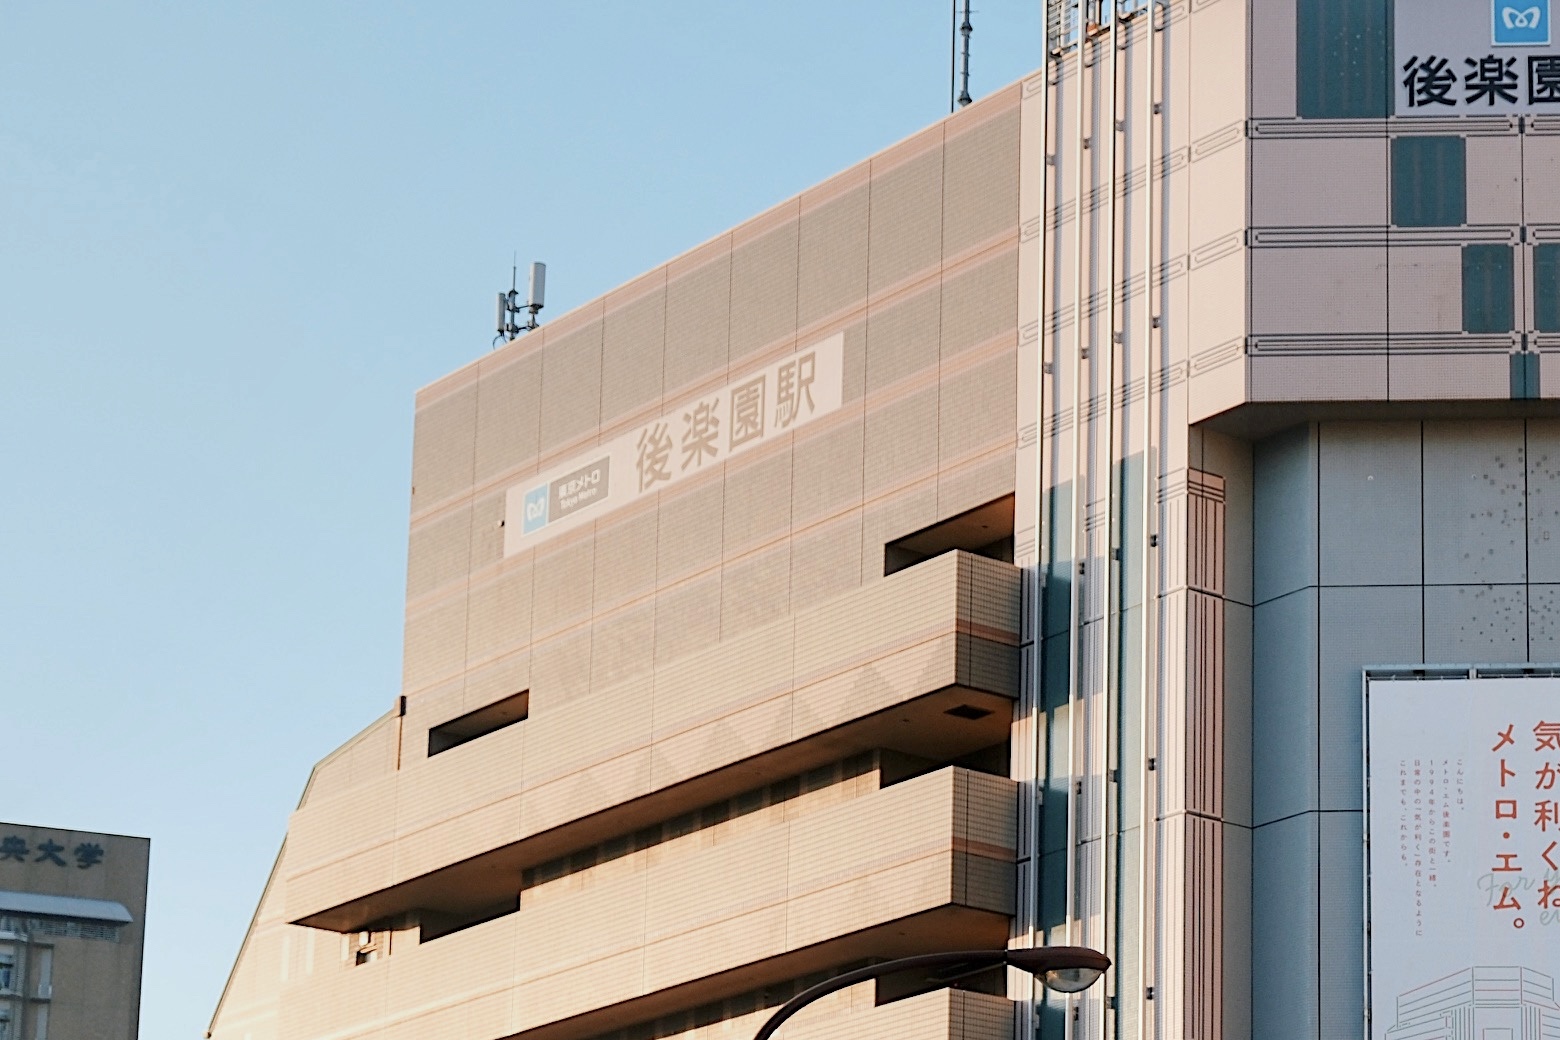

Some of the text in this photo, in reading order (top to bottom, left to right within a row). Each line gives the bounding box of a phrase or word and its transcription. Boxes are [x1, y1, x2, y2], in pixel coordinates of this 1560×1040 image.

[635, 351, 815, 493] 後楽園駅
[1477, 872, 1535, 907] For
[1492, 724, 1525, 928] メトロ・エム。
